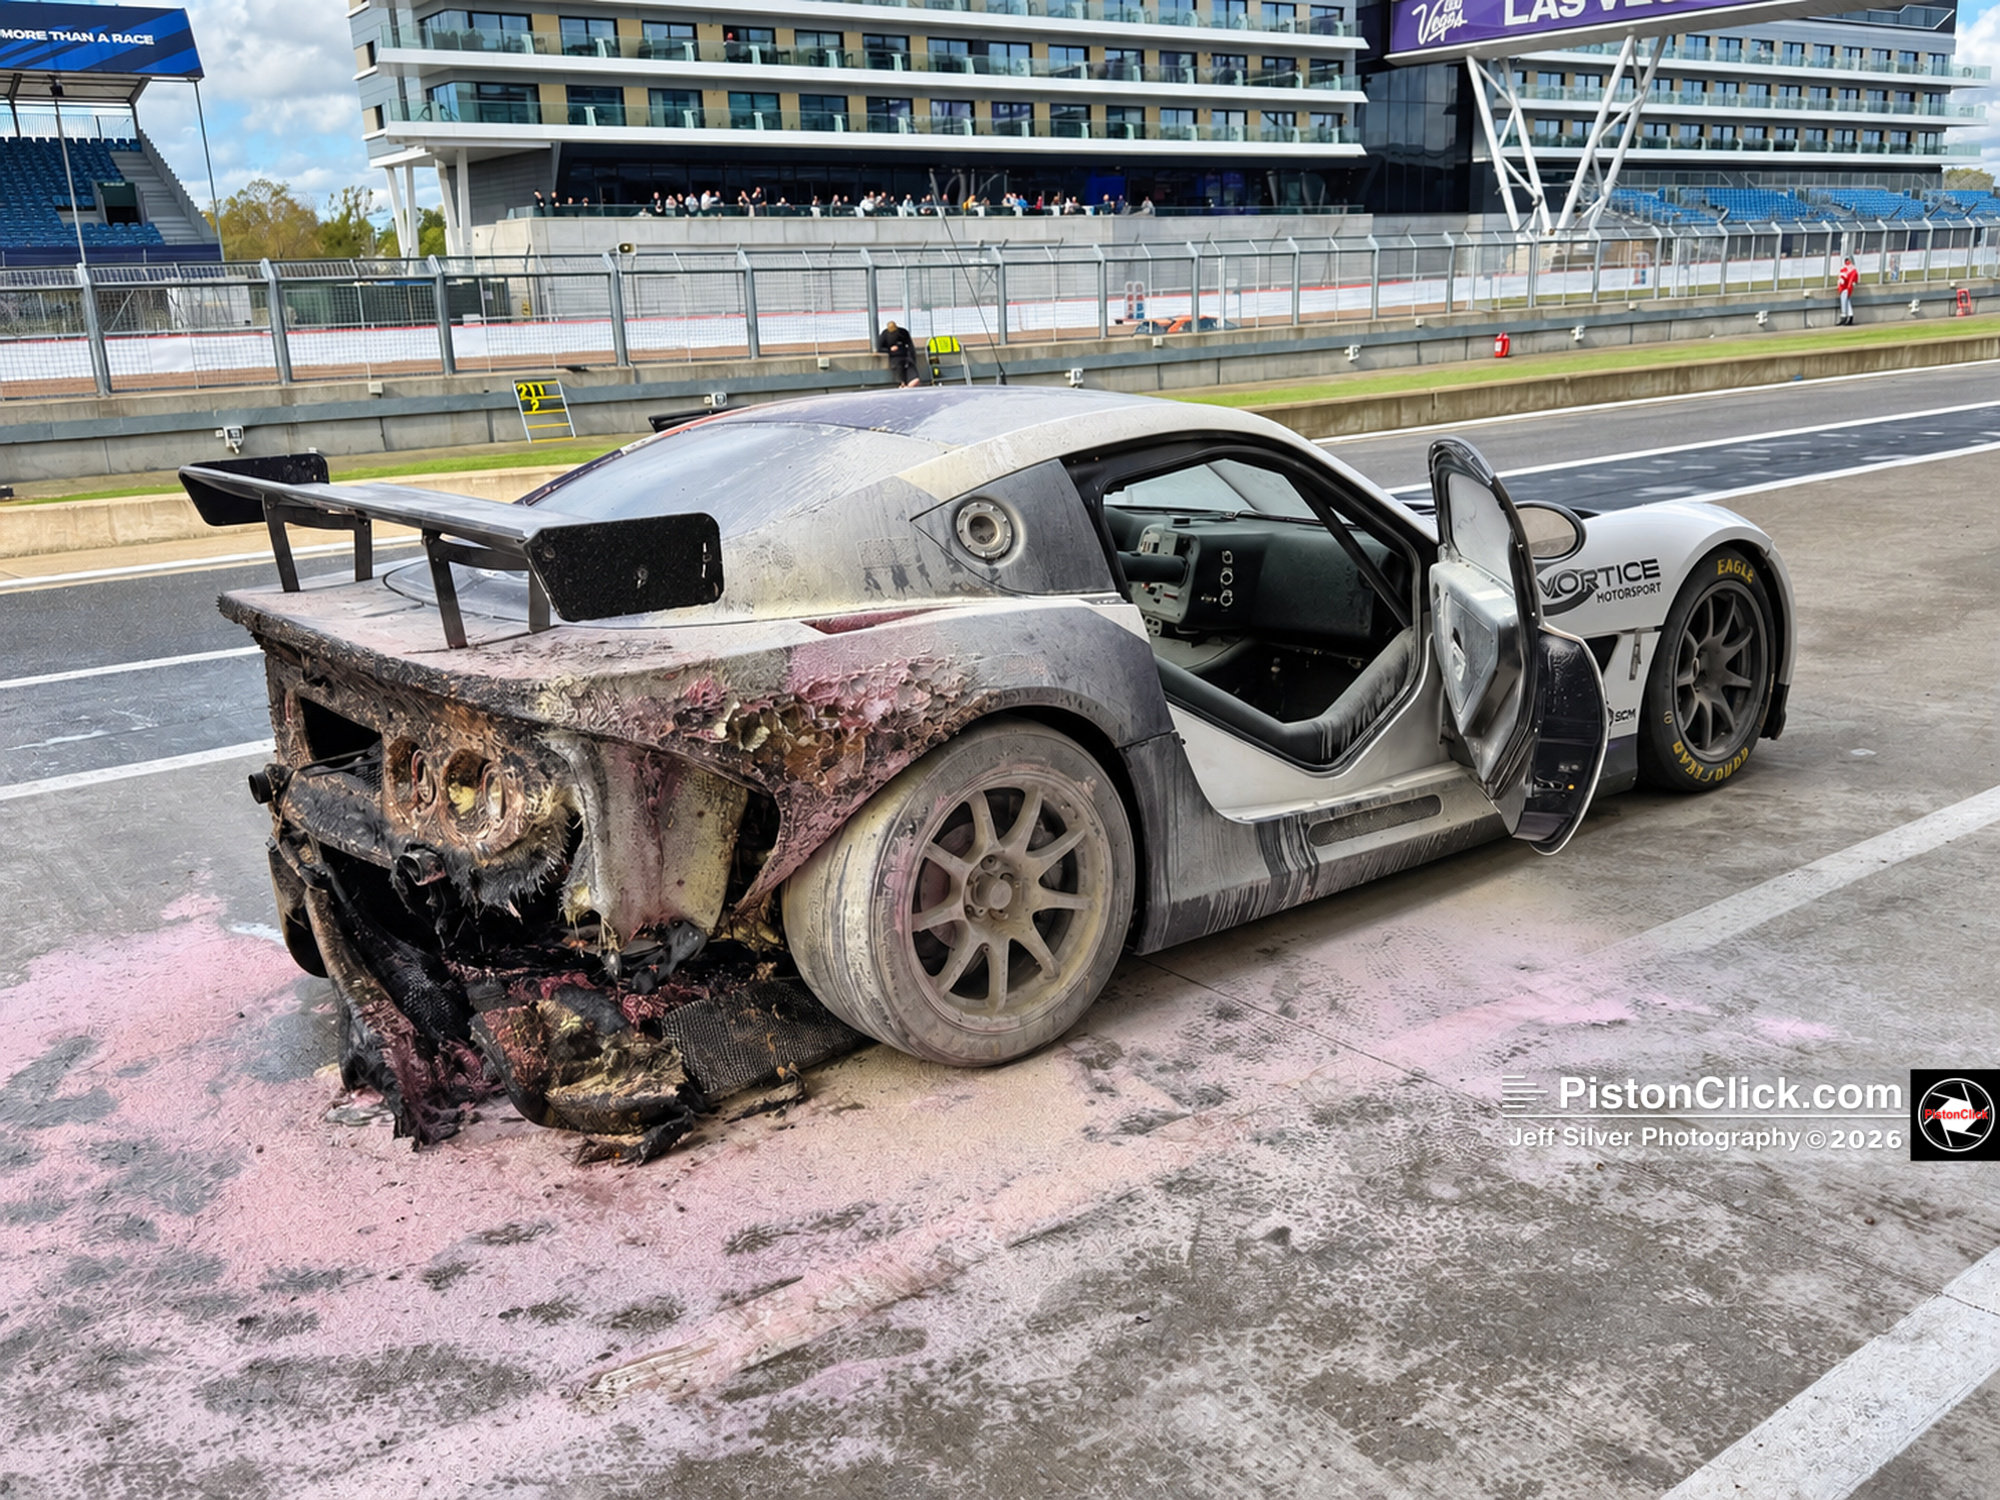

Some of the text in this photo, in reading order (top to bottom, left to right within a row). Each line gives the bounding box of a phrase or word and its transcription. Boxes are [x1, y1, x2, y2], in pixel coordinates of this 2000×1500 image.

[1411, 0, 1468, 45] Vegas
[0, 29, 154, 46] MORE THAN A RACE
[1537, 558, 1661, 599] VORTICE
[1717, 558, 1754, 584] EAGLE
[1596, 581, 1662, 603] MOTORSPORT
